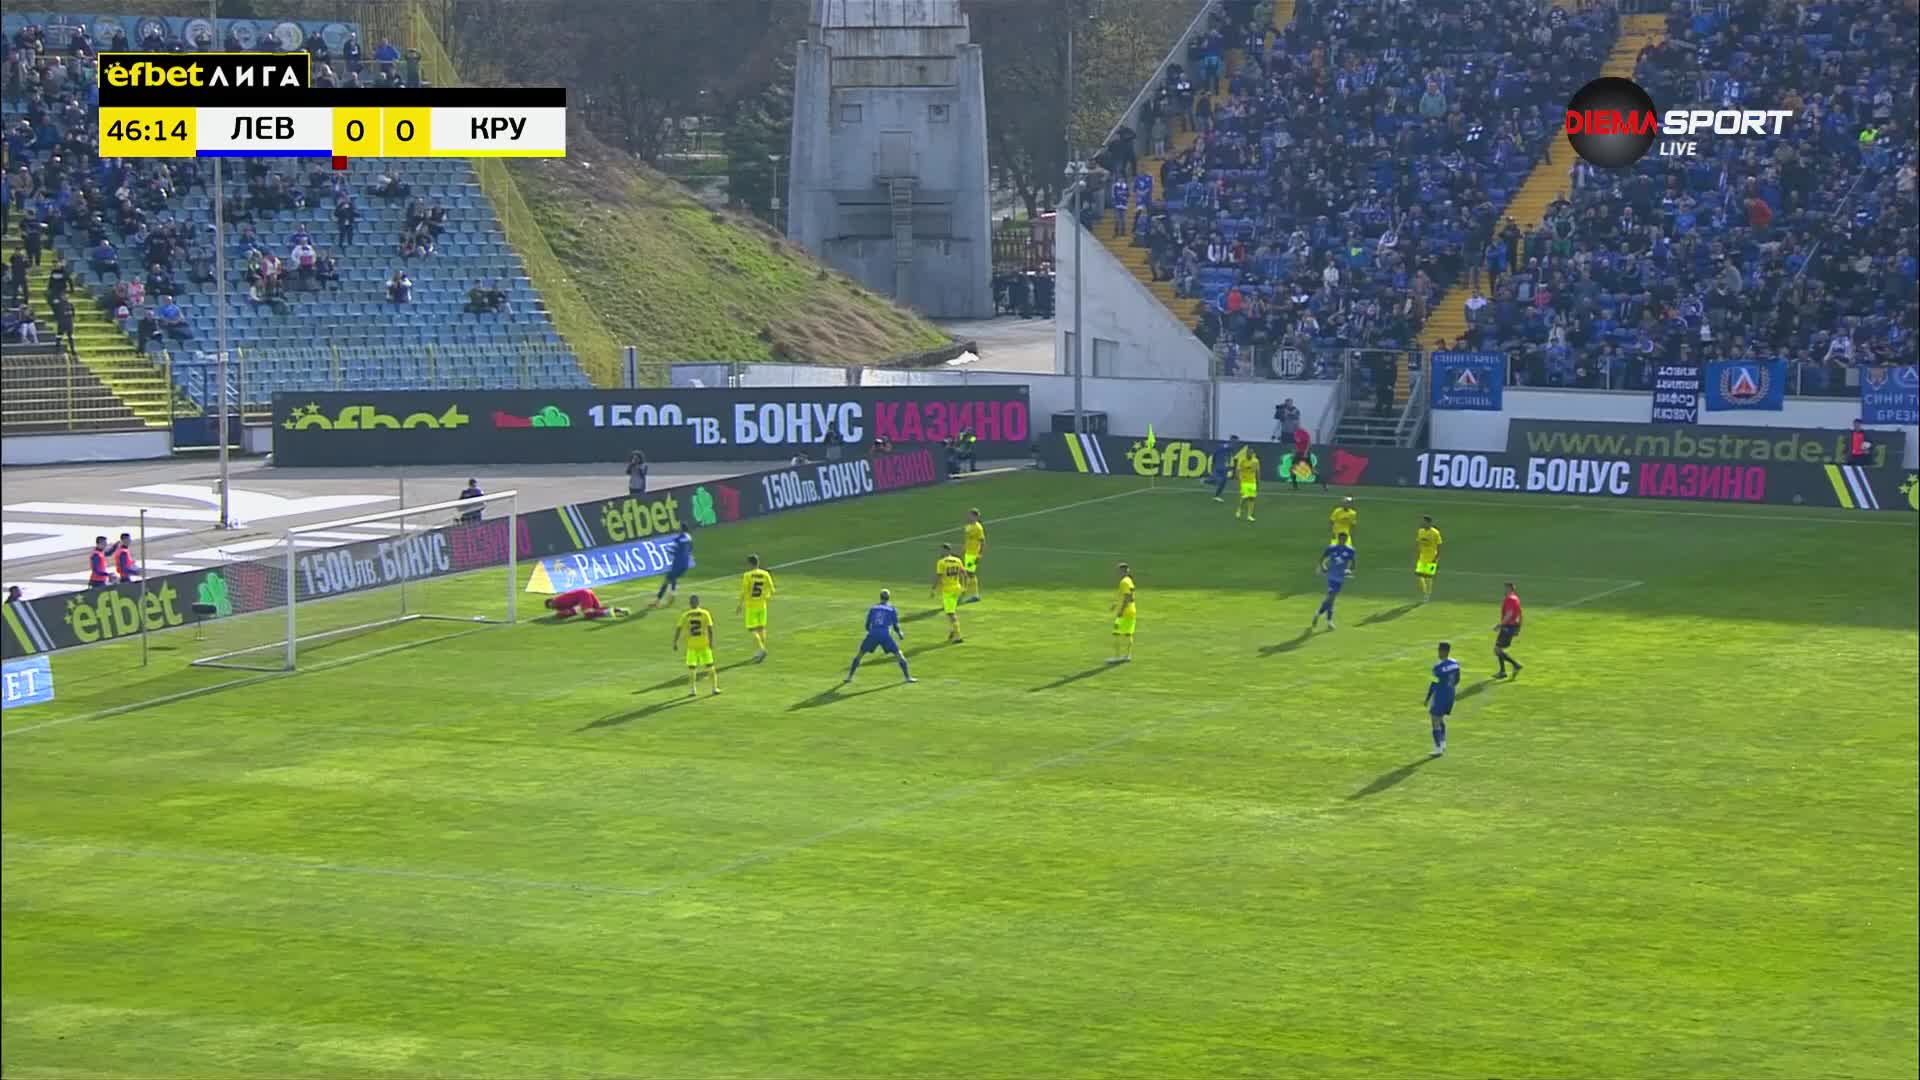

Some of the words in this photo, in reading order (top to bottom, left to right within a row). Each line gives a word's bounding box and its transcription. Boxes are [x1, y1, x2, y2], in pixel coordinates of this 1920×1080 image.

[733, 402, 863, 444] БОНУС
[873, 400, 1028, 443] КАЗИНО
[1133, 441, 1248, 477] efb
[1526, 457, 1630, 495] БОНУС
[1638, 463, 1767, 501] КАЗИНО
[607, 492, 680, 541] efbet
[816, 458, 873, 500] БОНУС
[873, 448, 936, 492] КАЗИНО
[643, 540, 676, 572] BE
[73, 579, 184, 643] efbet
[376, 532, 449, 582] БОНУС
[751, 581, 764, 598] 5
[689, 619, 702, 637] 2
[2, 668, 40, 702] ET
